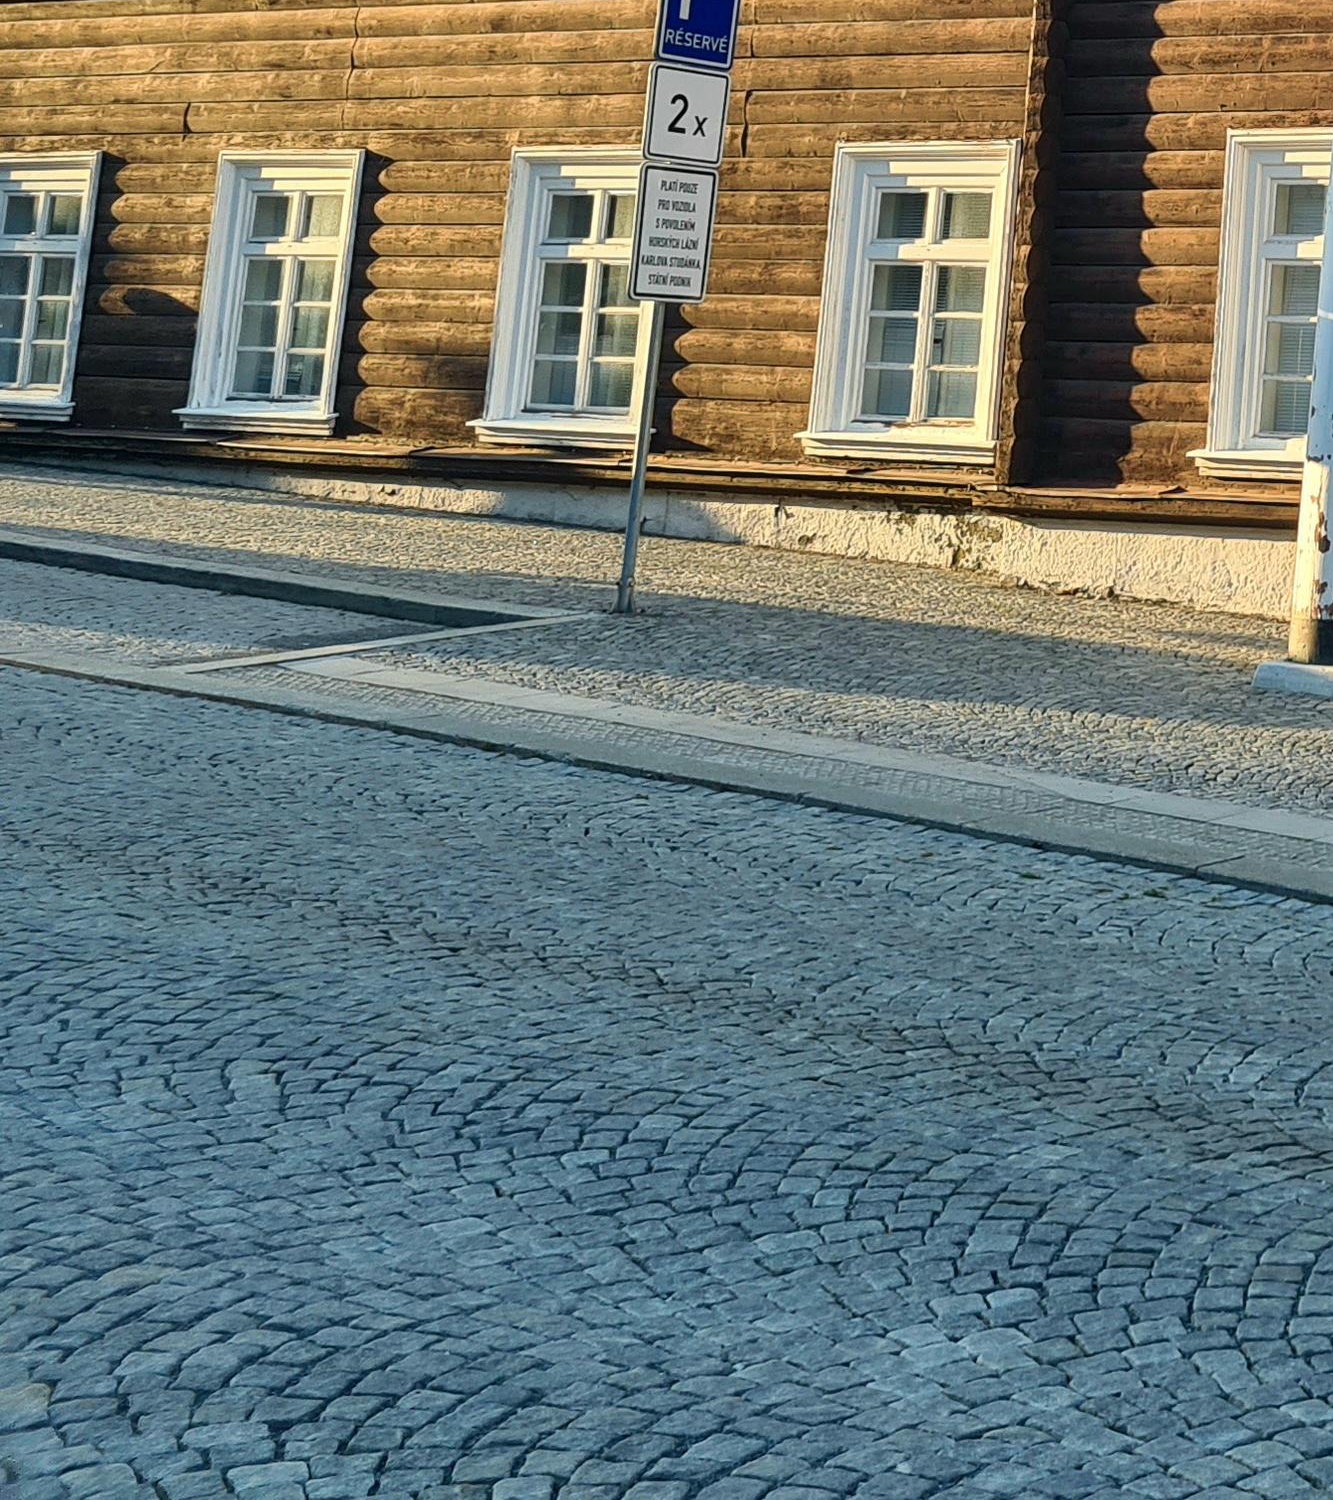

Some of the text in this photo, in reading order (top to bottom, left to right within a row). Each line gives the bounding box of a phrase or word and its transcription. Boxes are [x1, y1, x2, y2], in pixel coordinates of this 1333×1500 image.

[665, 27, 728, 53] RÉSERVÉ
[661, 179, 679, 193] PLATÍ
[657, 199, 696, 213] PRO VOZIDLA
[655, 218, 696, 232] S POVOLENÍM
[648, 235, 700, 250] HORSKÝCH LÁZNÍ
[641, 254, 668, 267] KARLOVA
[648, 271, 669, 285] STÁTNÍ
